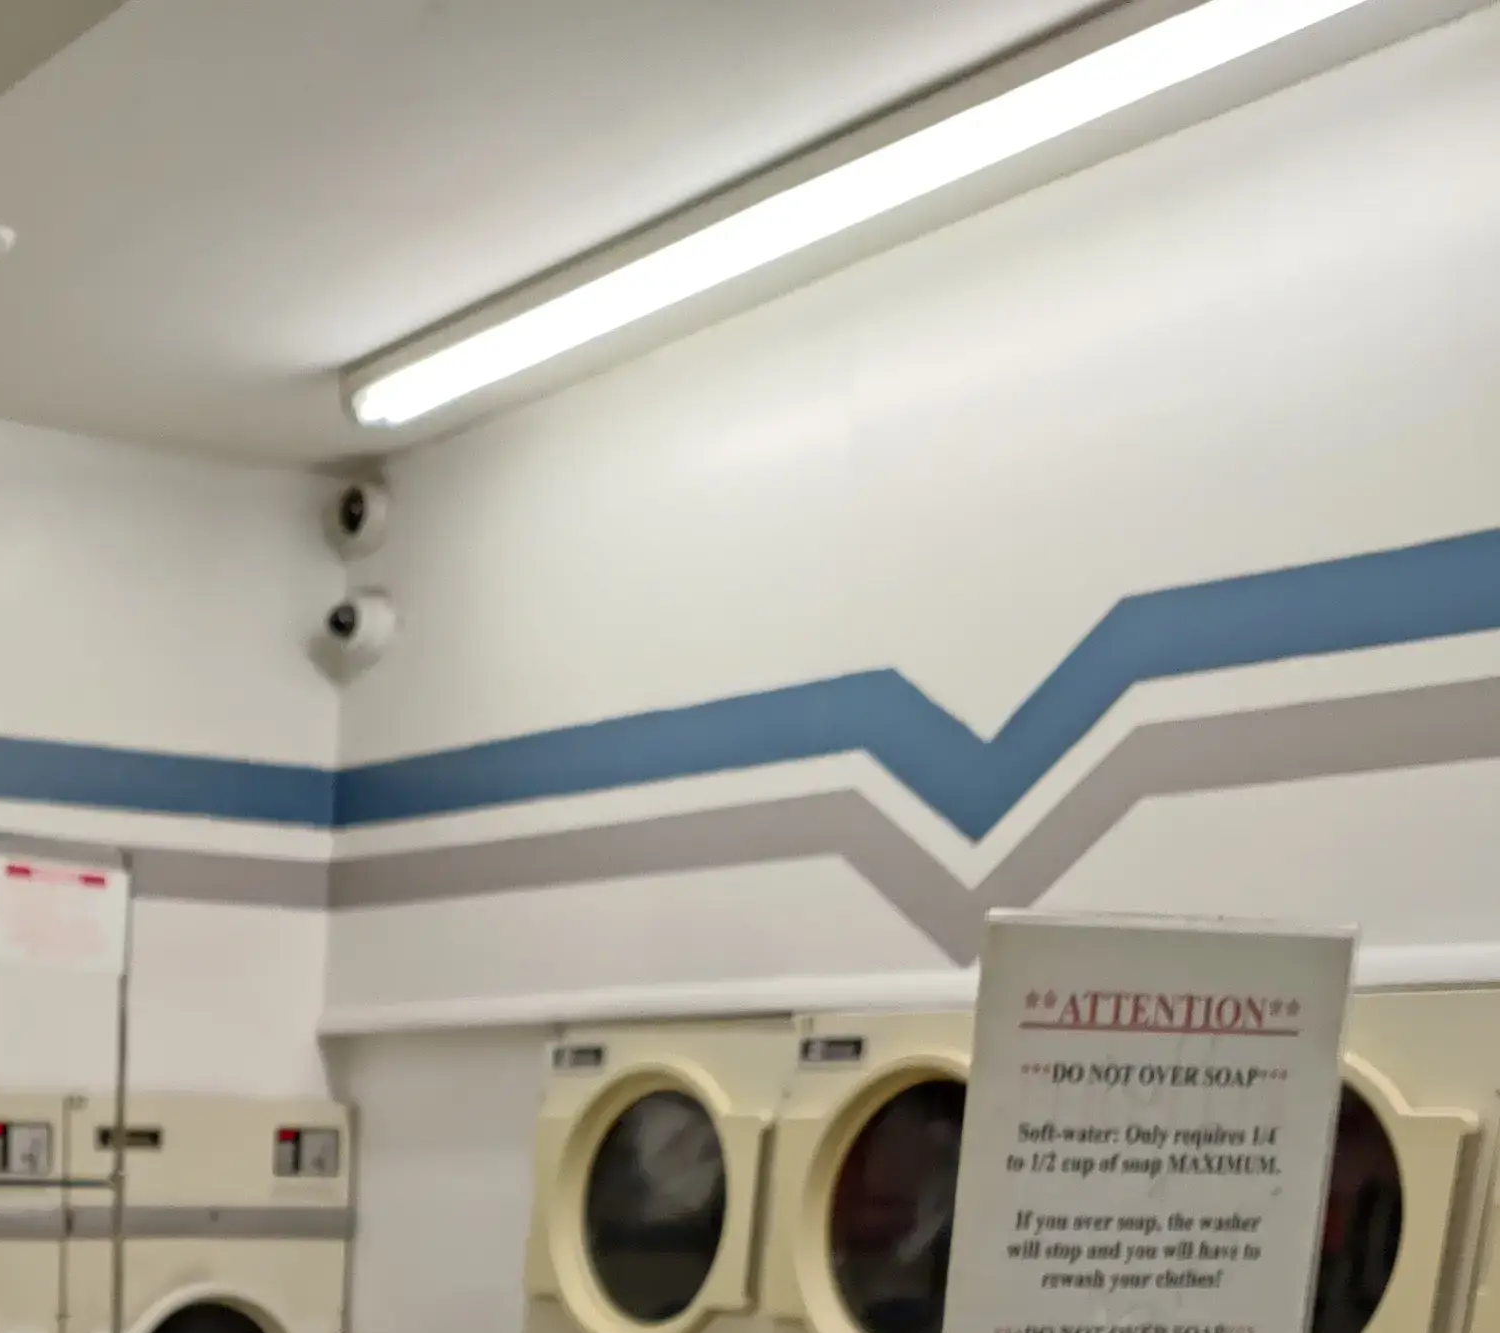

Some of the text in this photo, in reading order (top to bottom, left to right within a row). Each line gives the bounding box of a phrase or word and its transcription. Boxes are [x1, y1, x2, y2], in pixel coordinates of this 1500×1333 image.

[1089, 1062, 1136, 1087] NOT
[1138, 1064, 1199, 1087] OVER
[1124, 1124, 1169, 1149] Only
[1172, 1125, 1246, 1149] requires
[1006, 1153, 1026, 1172] to
[1030, 1151, 1057, 1173] 1/2
[1061, 1156, 1095, 1179] cup
[1098, 1153, 1120, 1173] of
[1121, 1156, 1163, 1179] soap
[1015, 1209, 1035, 1231] If
[1034, 1215, 1068, 1235] you
[1072, 1215, 1114, 1232] over
[1167, 1211, 1194, 1232] the
[1199, 1213, 1262, 1233] washer
[1006, 1240, 1262, 1265] will stop and you will have to
[1041, 1269, 1106, 1289] rewash
[1108, 1272, 1153, 1293] your
